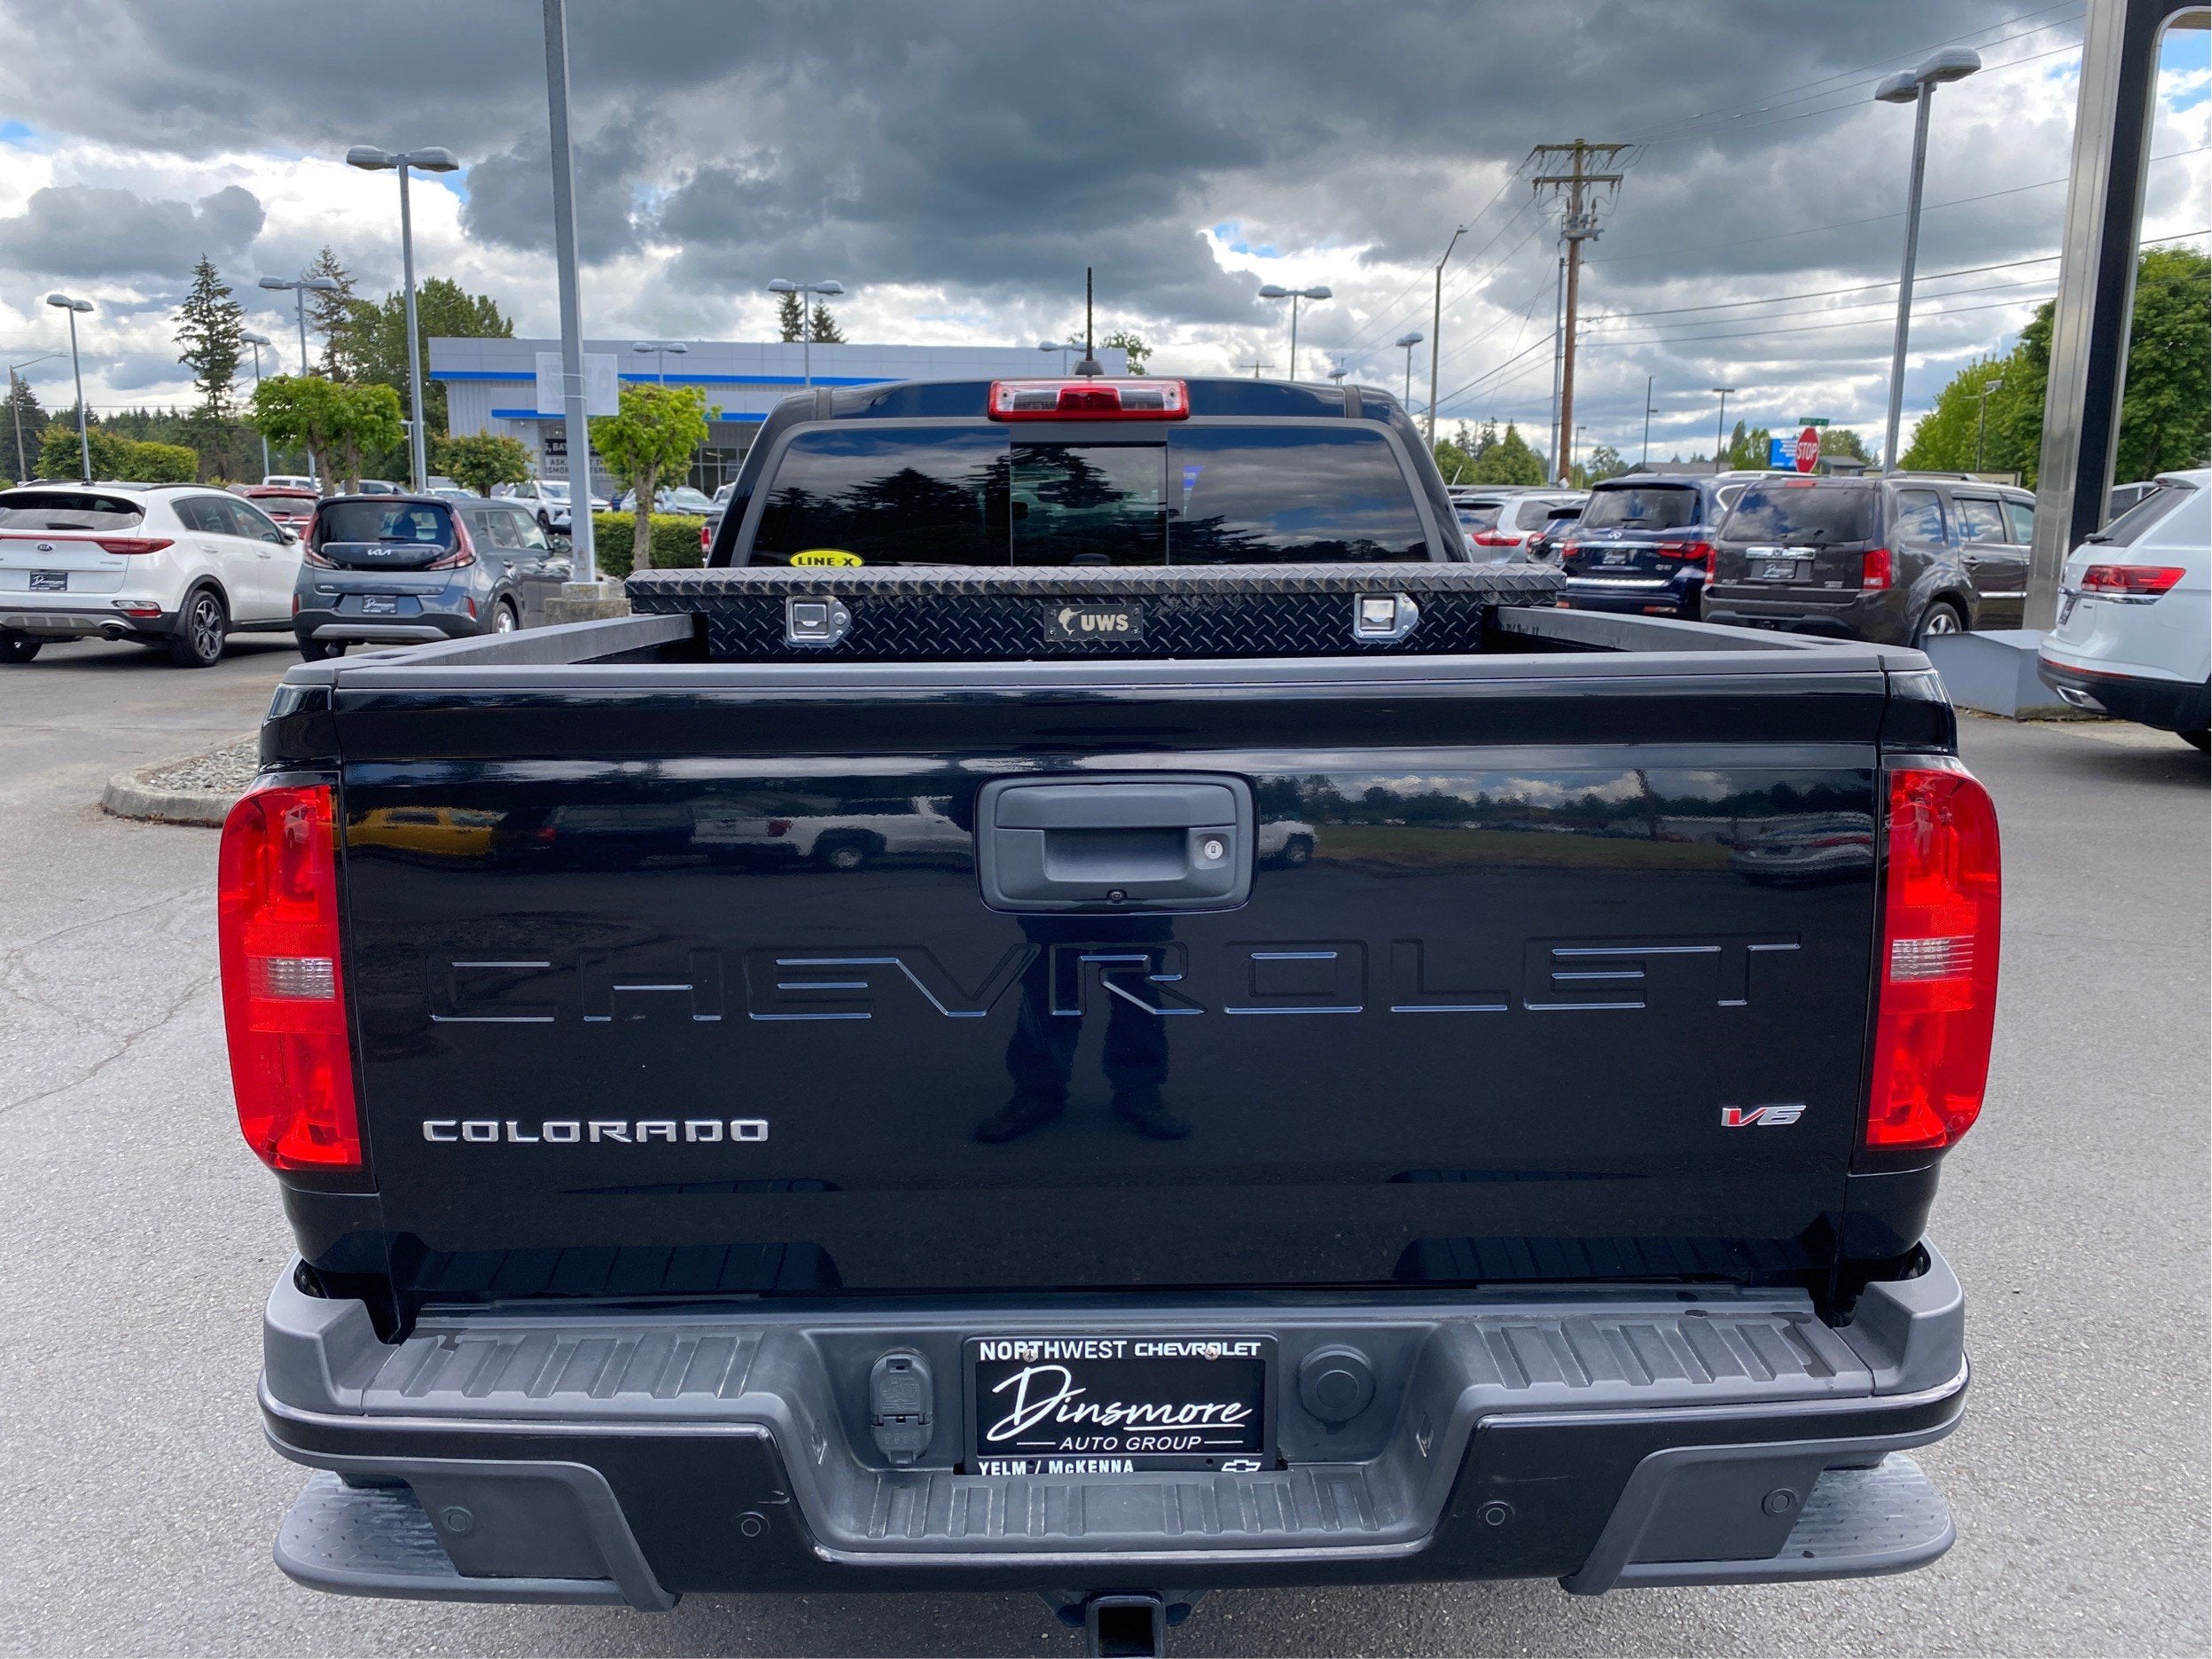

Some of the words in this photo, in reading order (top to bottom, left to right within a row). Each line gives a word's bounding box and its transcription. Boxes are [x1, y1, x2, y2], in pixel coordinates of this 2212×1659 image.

[1797, 442, 1817, 460] STOP
[1081, 614, 1129, 631] UWS
[426, 932, 1802, 1023] CHEVROLET
[1720, 1104, 1807, 1128] V6
[422, 1119, 770, 1144] COLORADO
[980, 1341, 1127, 1361] NORTHWEST
[986, 1365, 1253, 1442] Dinsmore
[1059, 1436, 1119, 1451] AUTO
[1125, 1436, 1201, 1451] GROUP
[979, 1461, 1027, 1475] YELM
[1048, 1459, 1134, 1474] McKENNA
